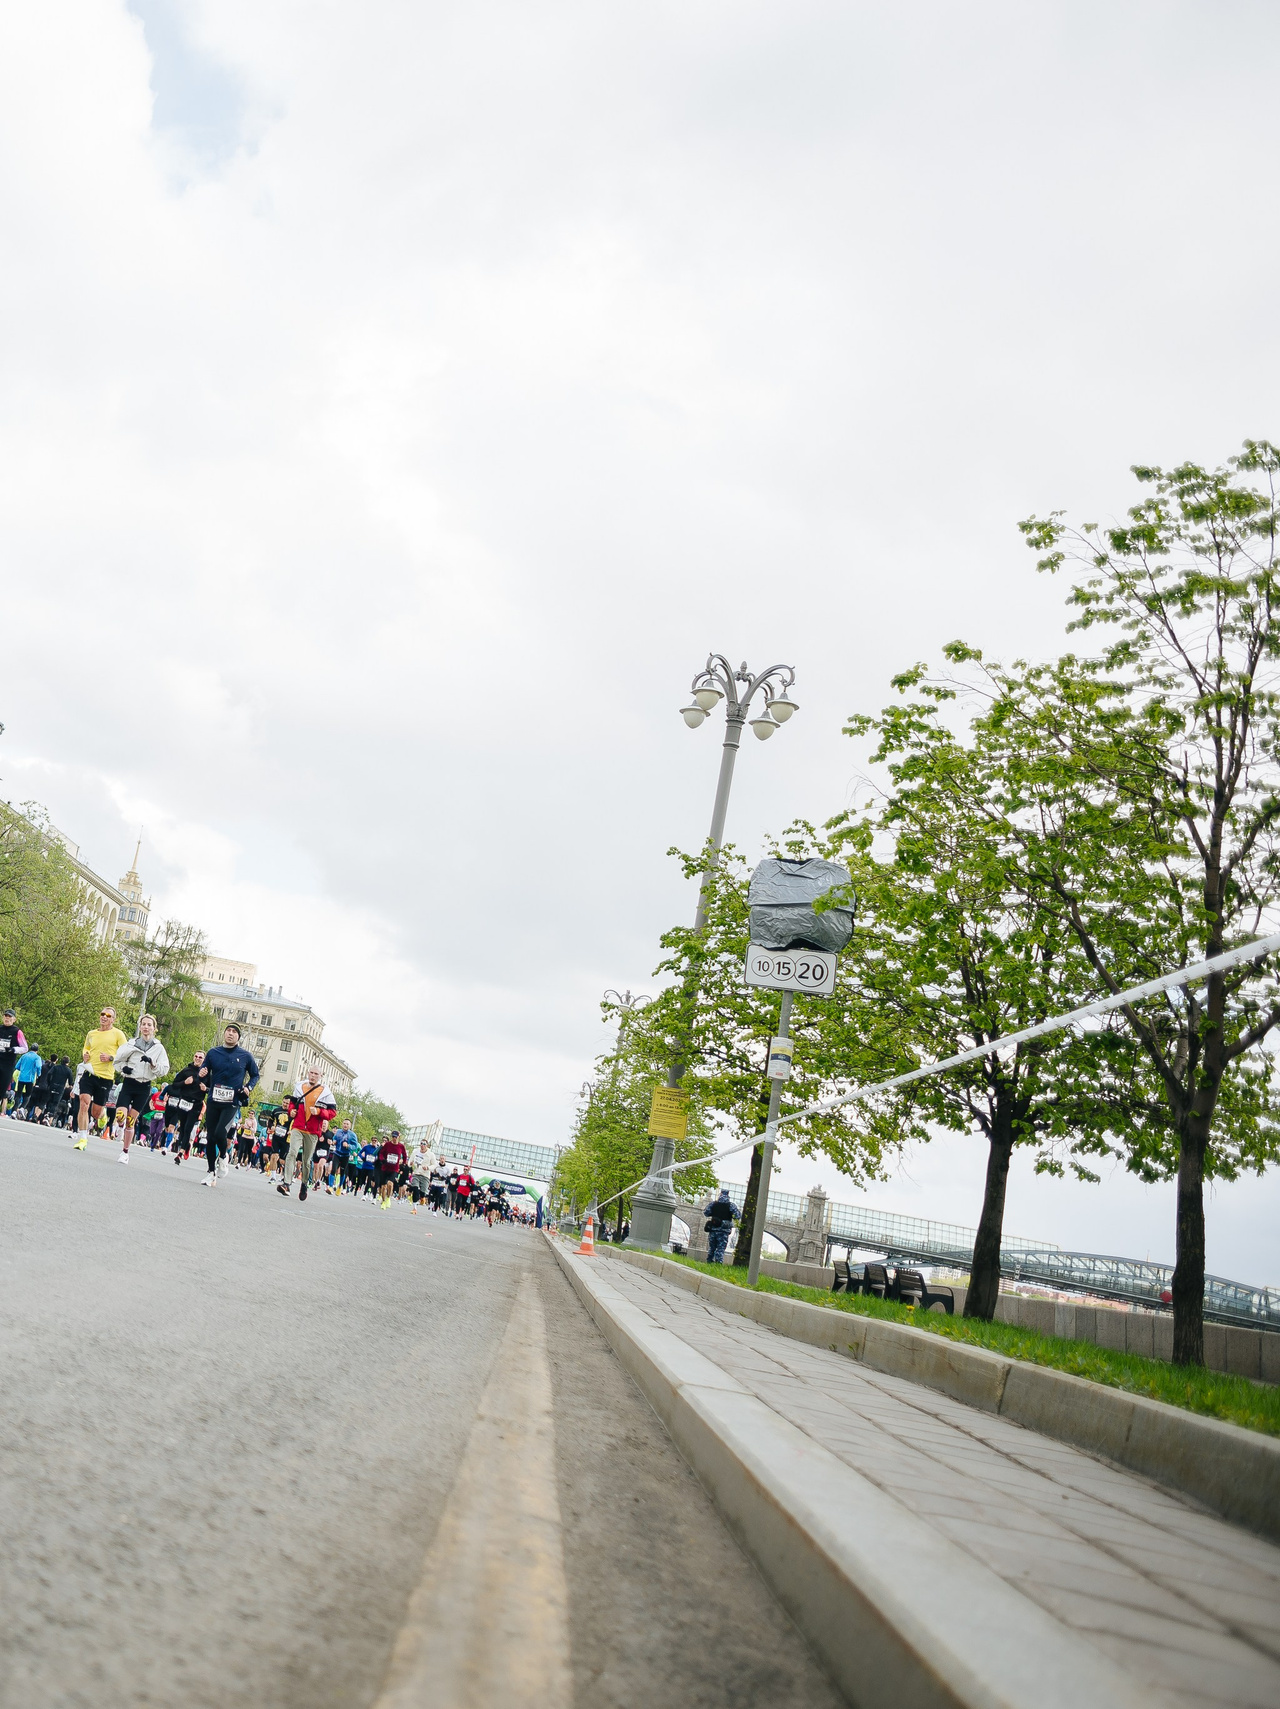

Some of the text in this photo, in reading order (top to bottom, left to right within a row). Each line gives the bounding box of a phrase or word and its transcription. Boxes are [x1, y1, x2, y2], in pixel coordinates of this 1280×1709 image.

[757, 961, 824, 981] 10 15 20
[214, 1089, 233, 1098] 15615
